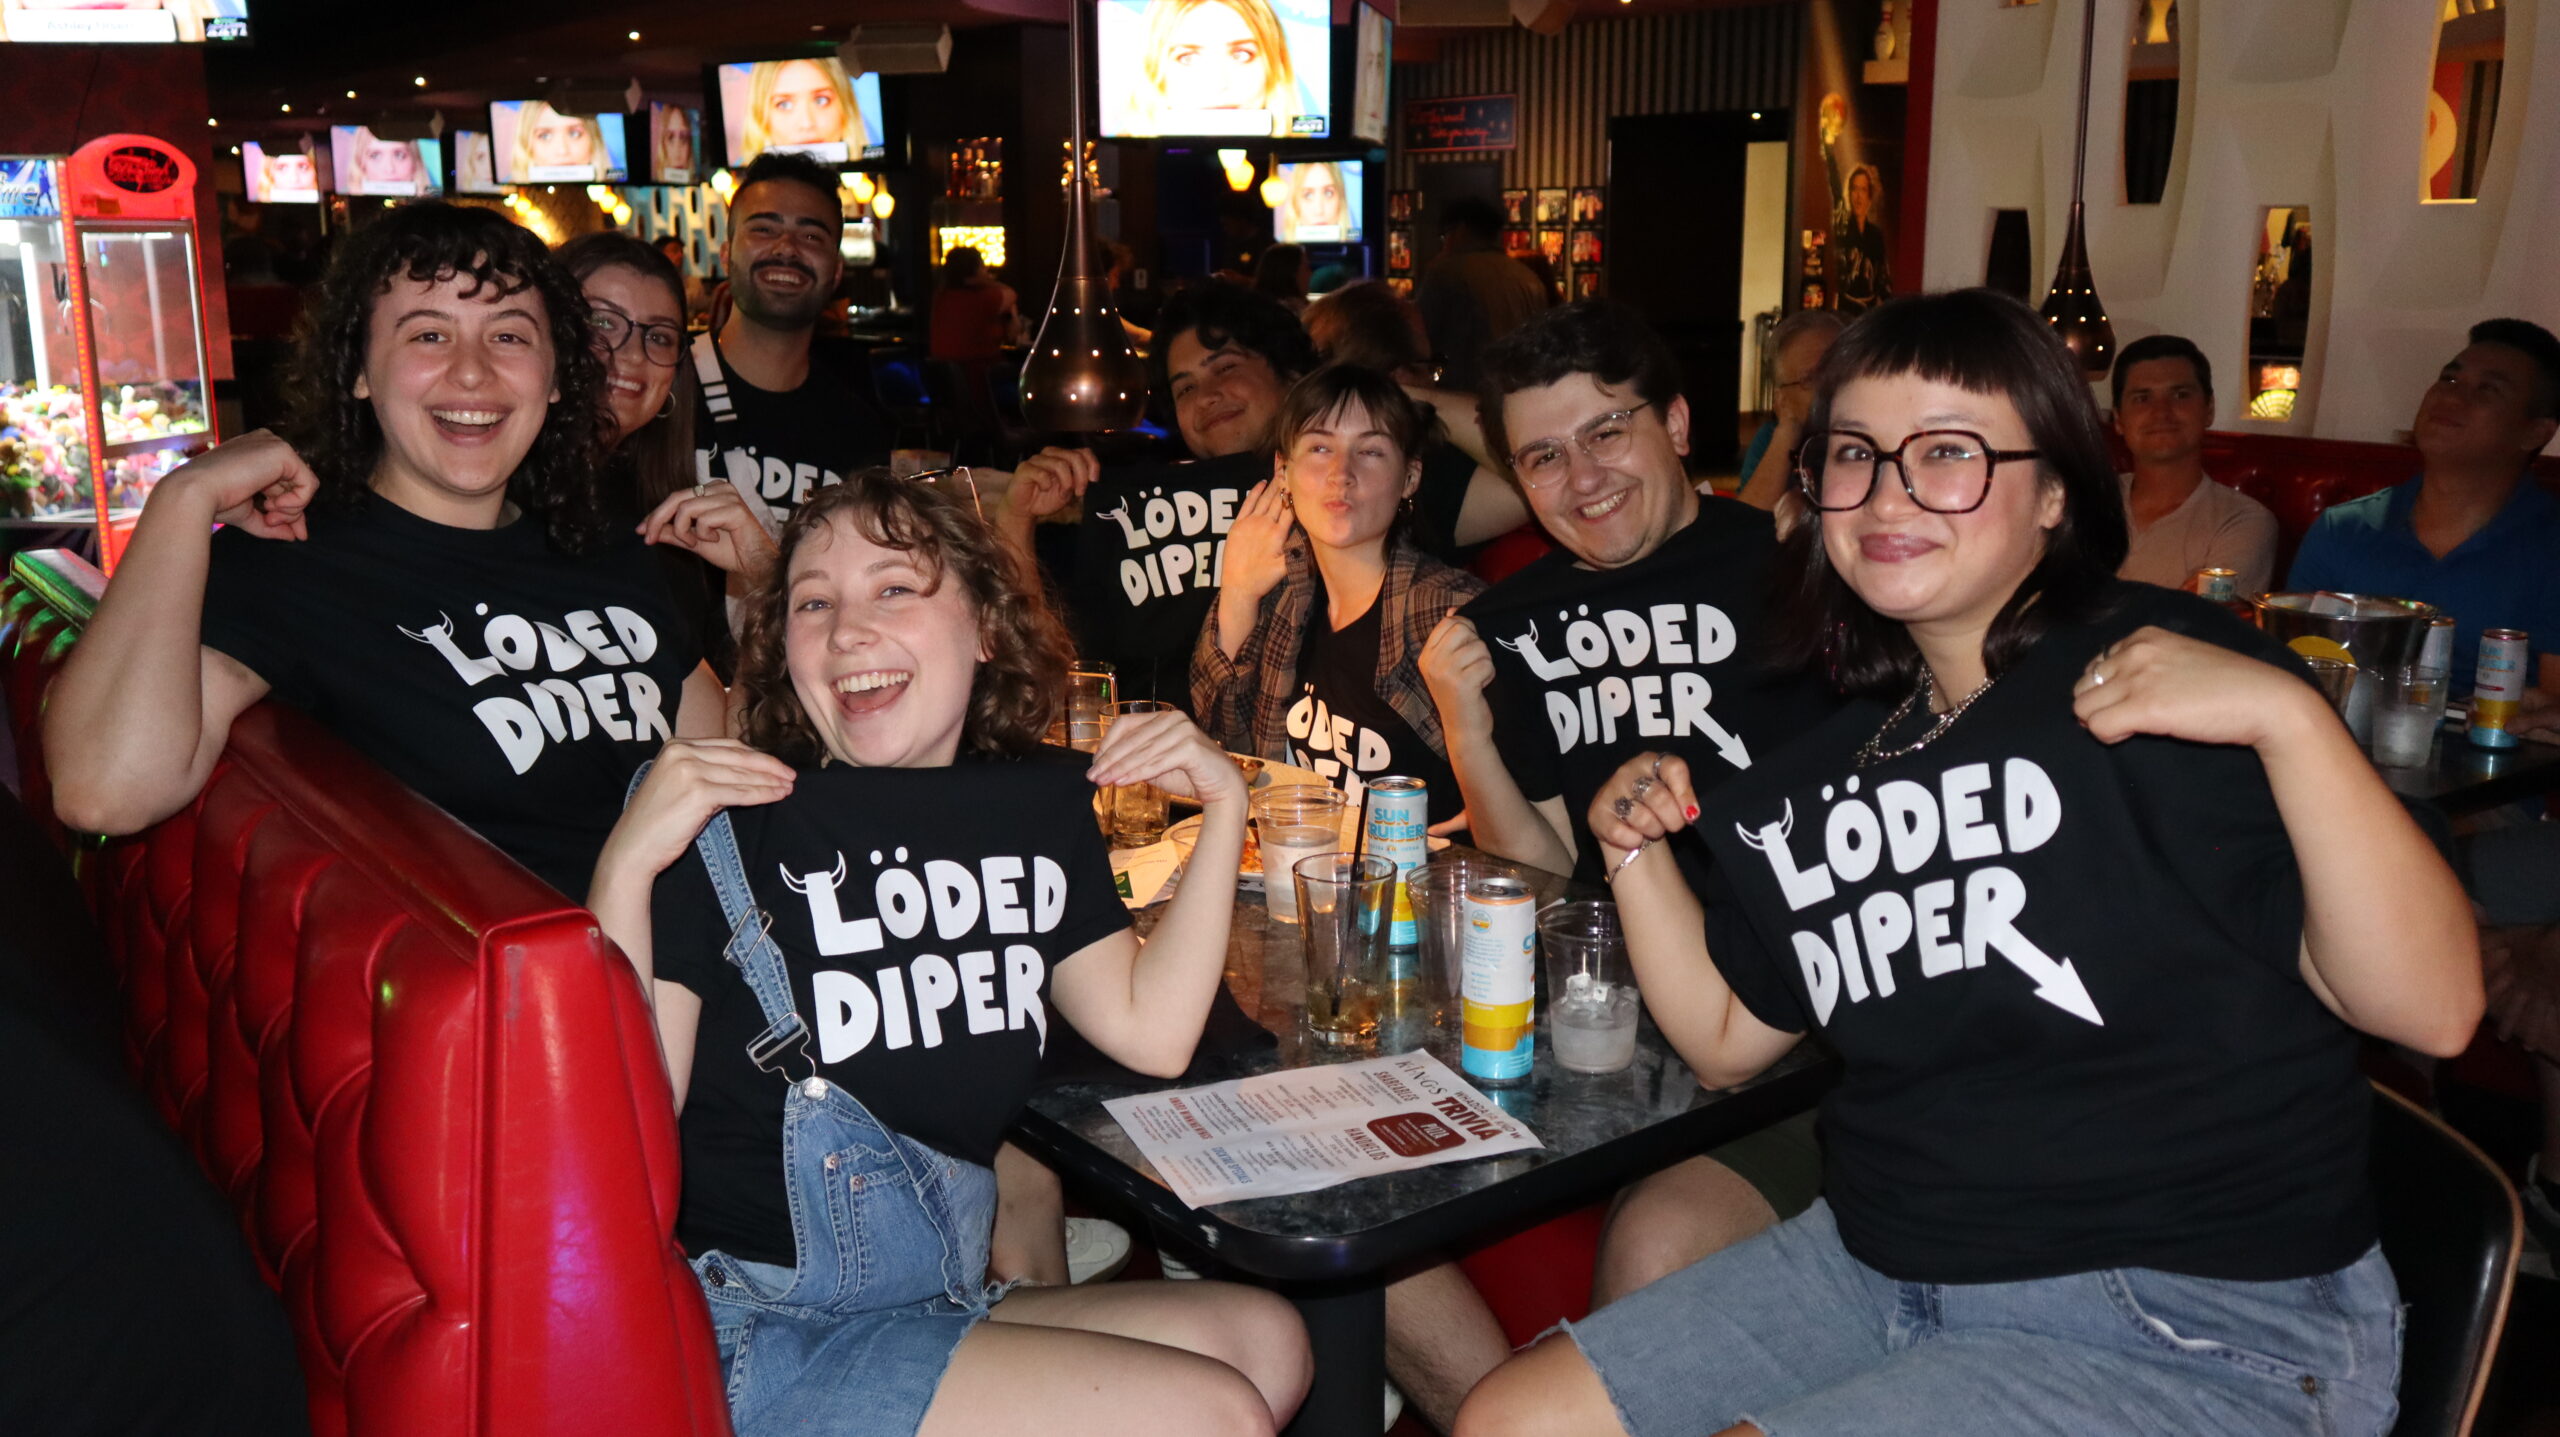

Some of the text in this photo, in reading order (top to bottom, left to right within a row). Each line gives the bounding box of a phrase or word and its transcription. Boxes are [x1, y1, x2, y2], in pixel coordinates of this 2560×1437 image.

[1096, 487, 1253, 549] LÖDE
[1496, 604, 1737, 682] LÖDED
[1287, 682, 1391, 771] ÖDED
[1545, 672, 1752, 770] DIPER
[1368, 822, 1425, 841] RUISER
[1374, 808, 1410, 824] SUN
[1736, 758, 2062, 911] LÖDED
[779, 847, 1067, 956] LÖDED
[1791, 867, 2104, 1026] DIPER
[813, 945, 1047, 1059] DIPER
[1432, 1096, 1503, 1141] TRIVIA
